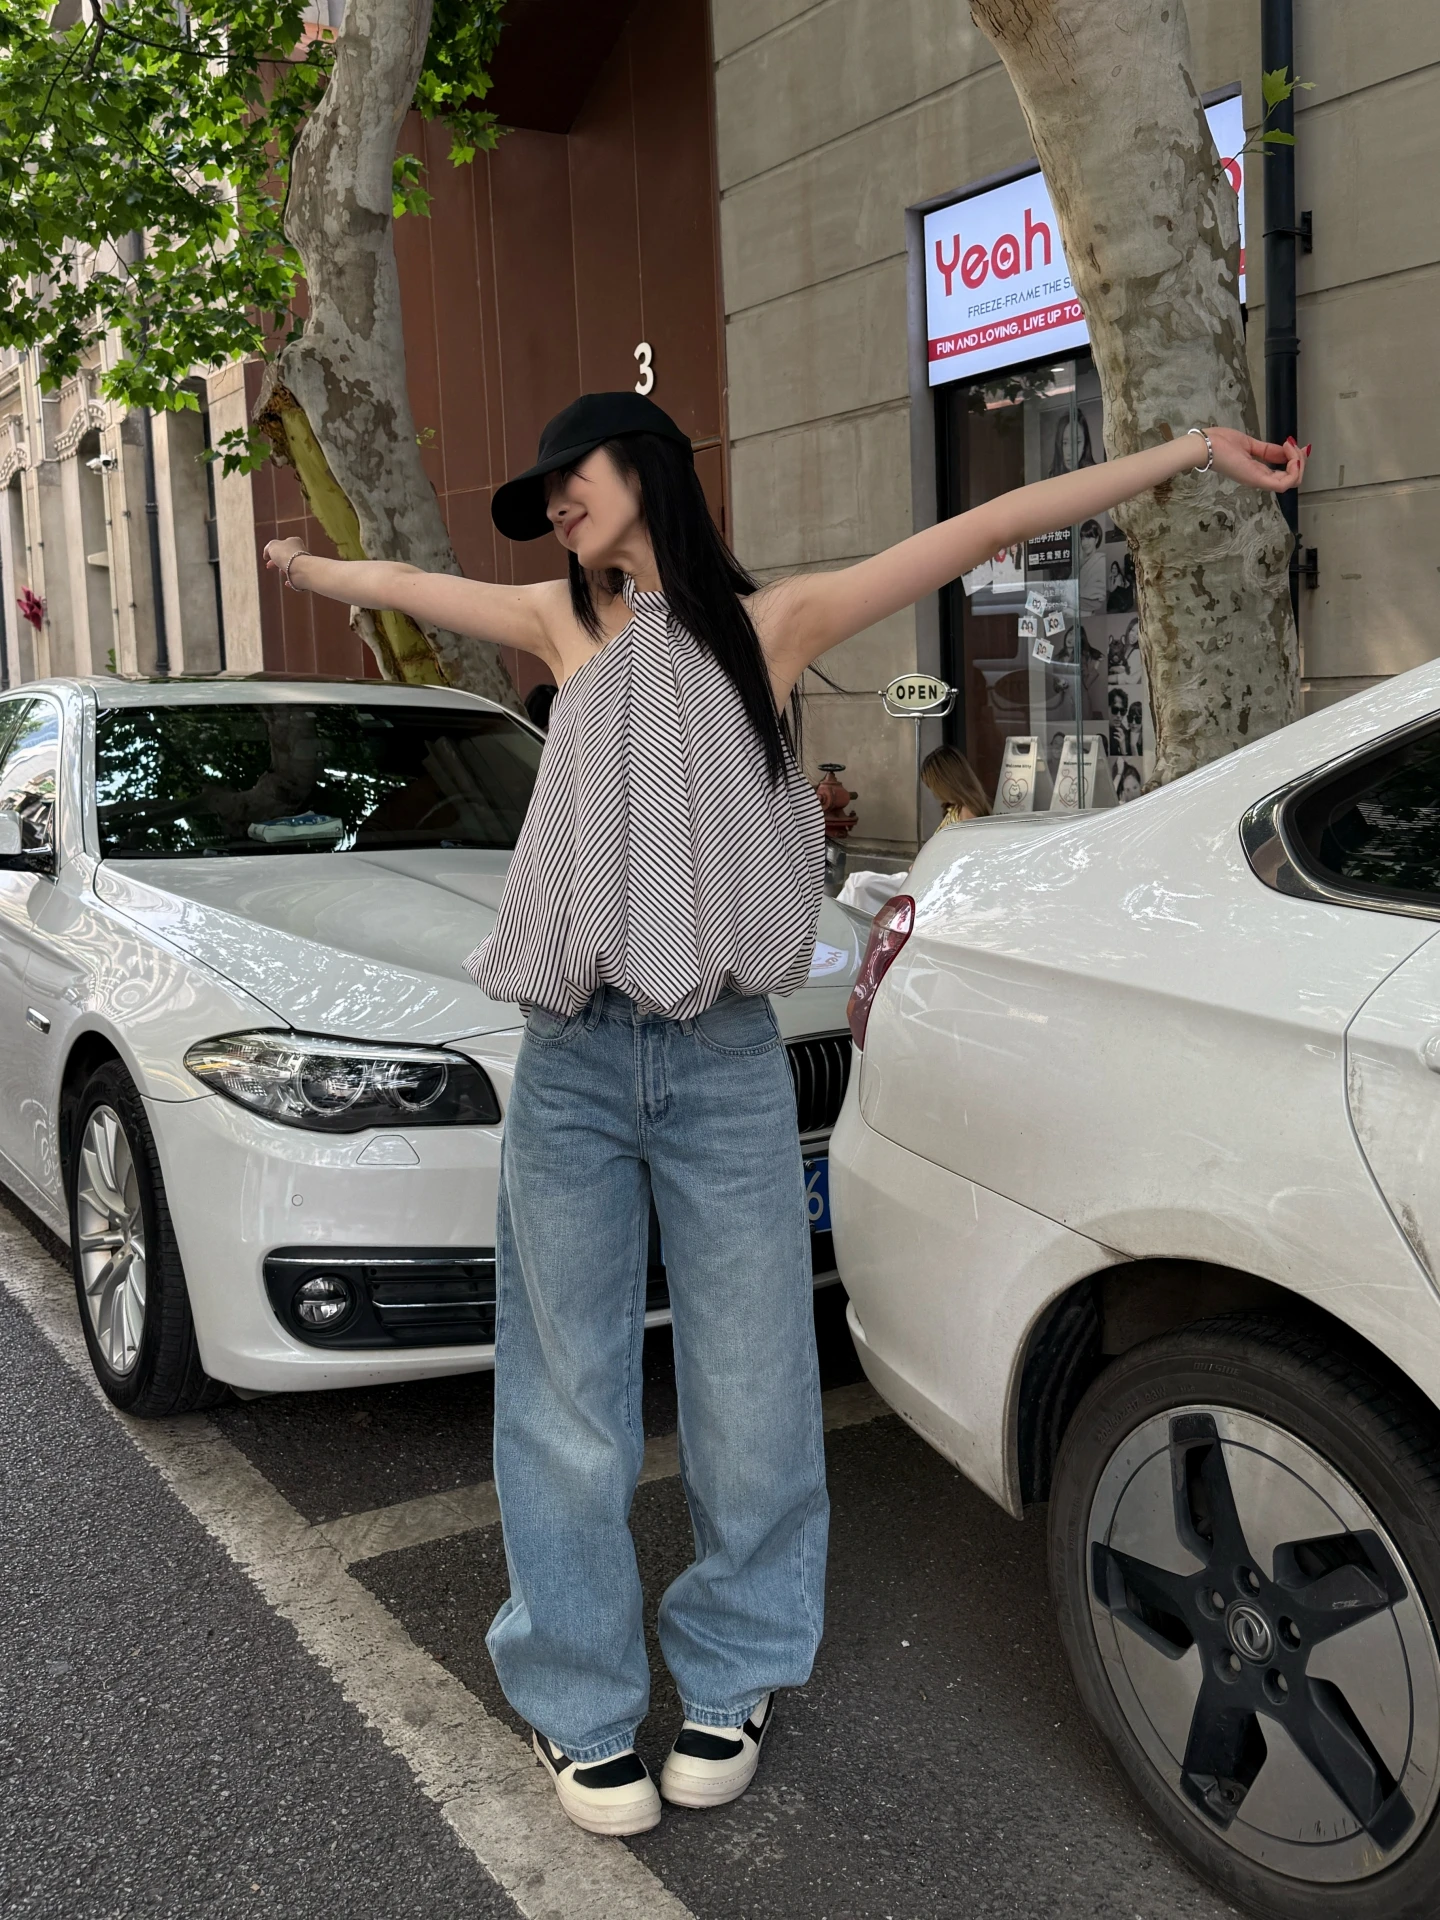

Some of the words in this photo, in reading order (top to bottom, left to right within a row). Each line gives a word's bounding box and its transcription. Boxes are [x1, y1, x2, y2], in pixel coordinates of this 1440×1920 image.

[935, 208, 1051, 297] Yeah
[968, 286, 1040, 318] FREEZE-FRAME
[1042, 279, 1062, 295] THE
[936, 339, 955, 355] FUN
[956, 333, 978, 351] AND
[980, 322, 1021, 344] LOVING,
[1023, 314, 1046, 331] LIVE
[1047, 309, 1061, 324] UP
[1063, 303, 1081, 319] TO
[633, 342, 654, 396] 3
[896, 685, 937, 700] OPEN
[807, 1170, 824, 1221] 6
